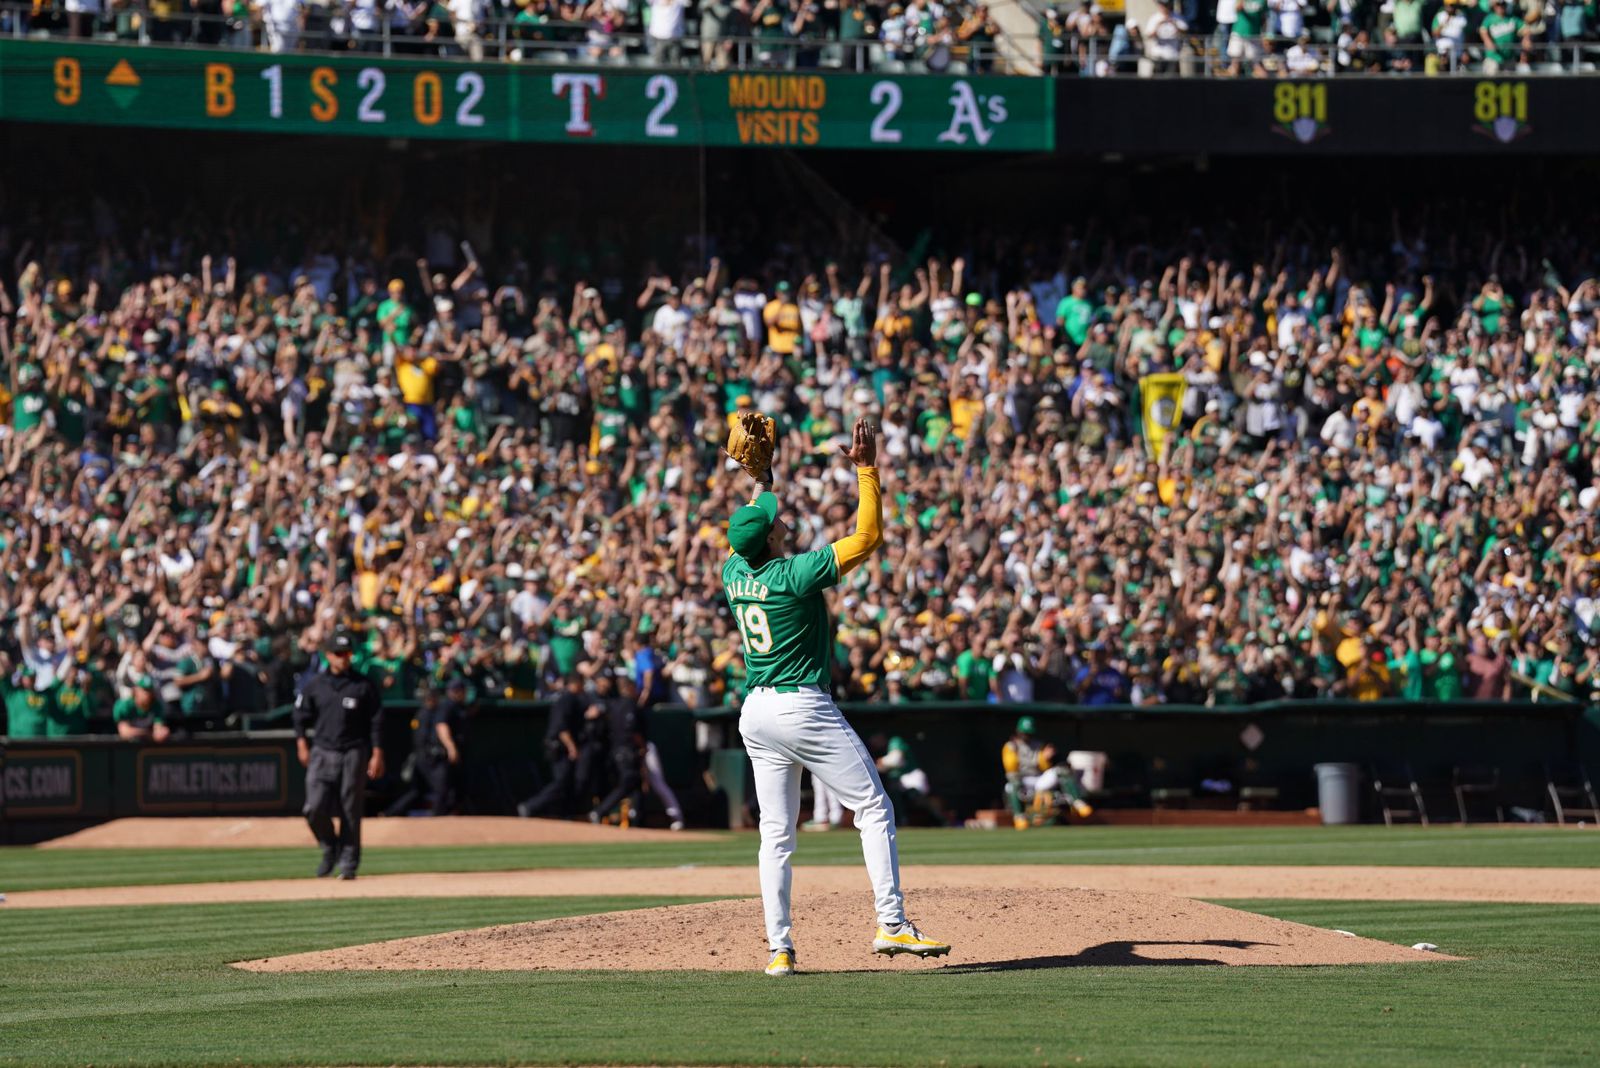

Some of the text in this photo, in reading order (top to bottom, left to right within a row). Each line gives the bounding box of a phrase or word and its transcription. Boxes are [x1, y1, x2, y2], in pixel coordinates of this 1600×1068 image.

[54, 57, 82, 105] 9
[205, 62, 236, 117] B
[260, 64, 283, 119] 1
[310, 67, 338, 122] S
[357, 67, 386, 122] 2
[455, 72, 485, 126] 2
[728, 75, 826, 109] MOUND
[1274, 82, 1327, 122] 811
[1474, 82, 1528, 122] 811
[552, 73, 678, 137] T 2
[870, 80, 902, 142] 2
[737, 110, 820, 145] VISITS
[736, 603, 774, 655] 19
[148, 762, 277, 795] ATHLETICS.COM
